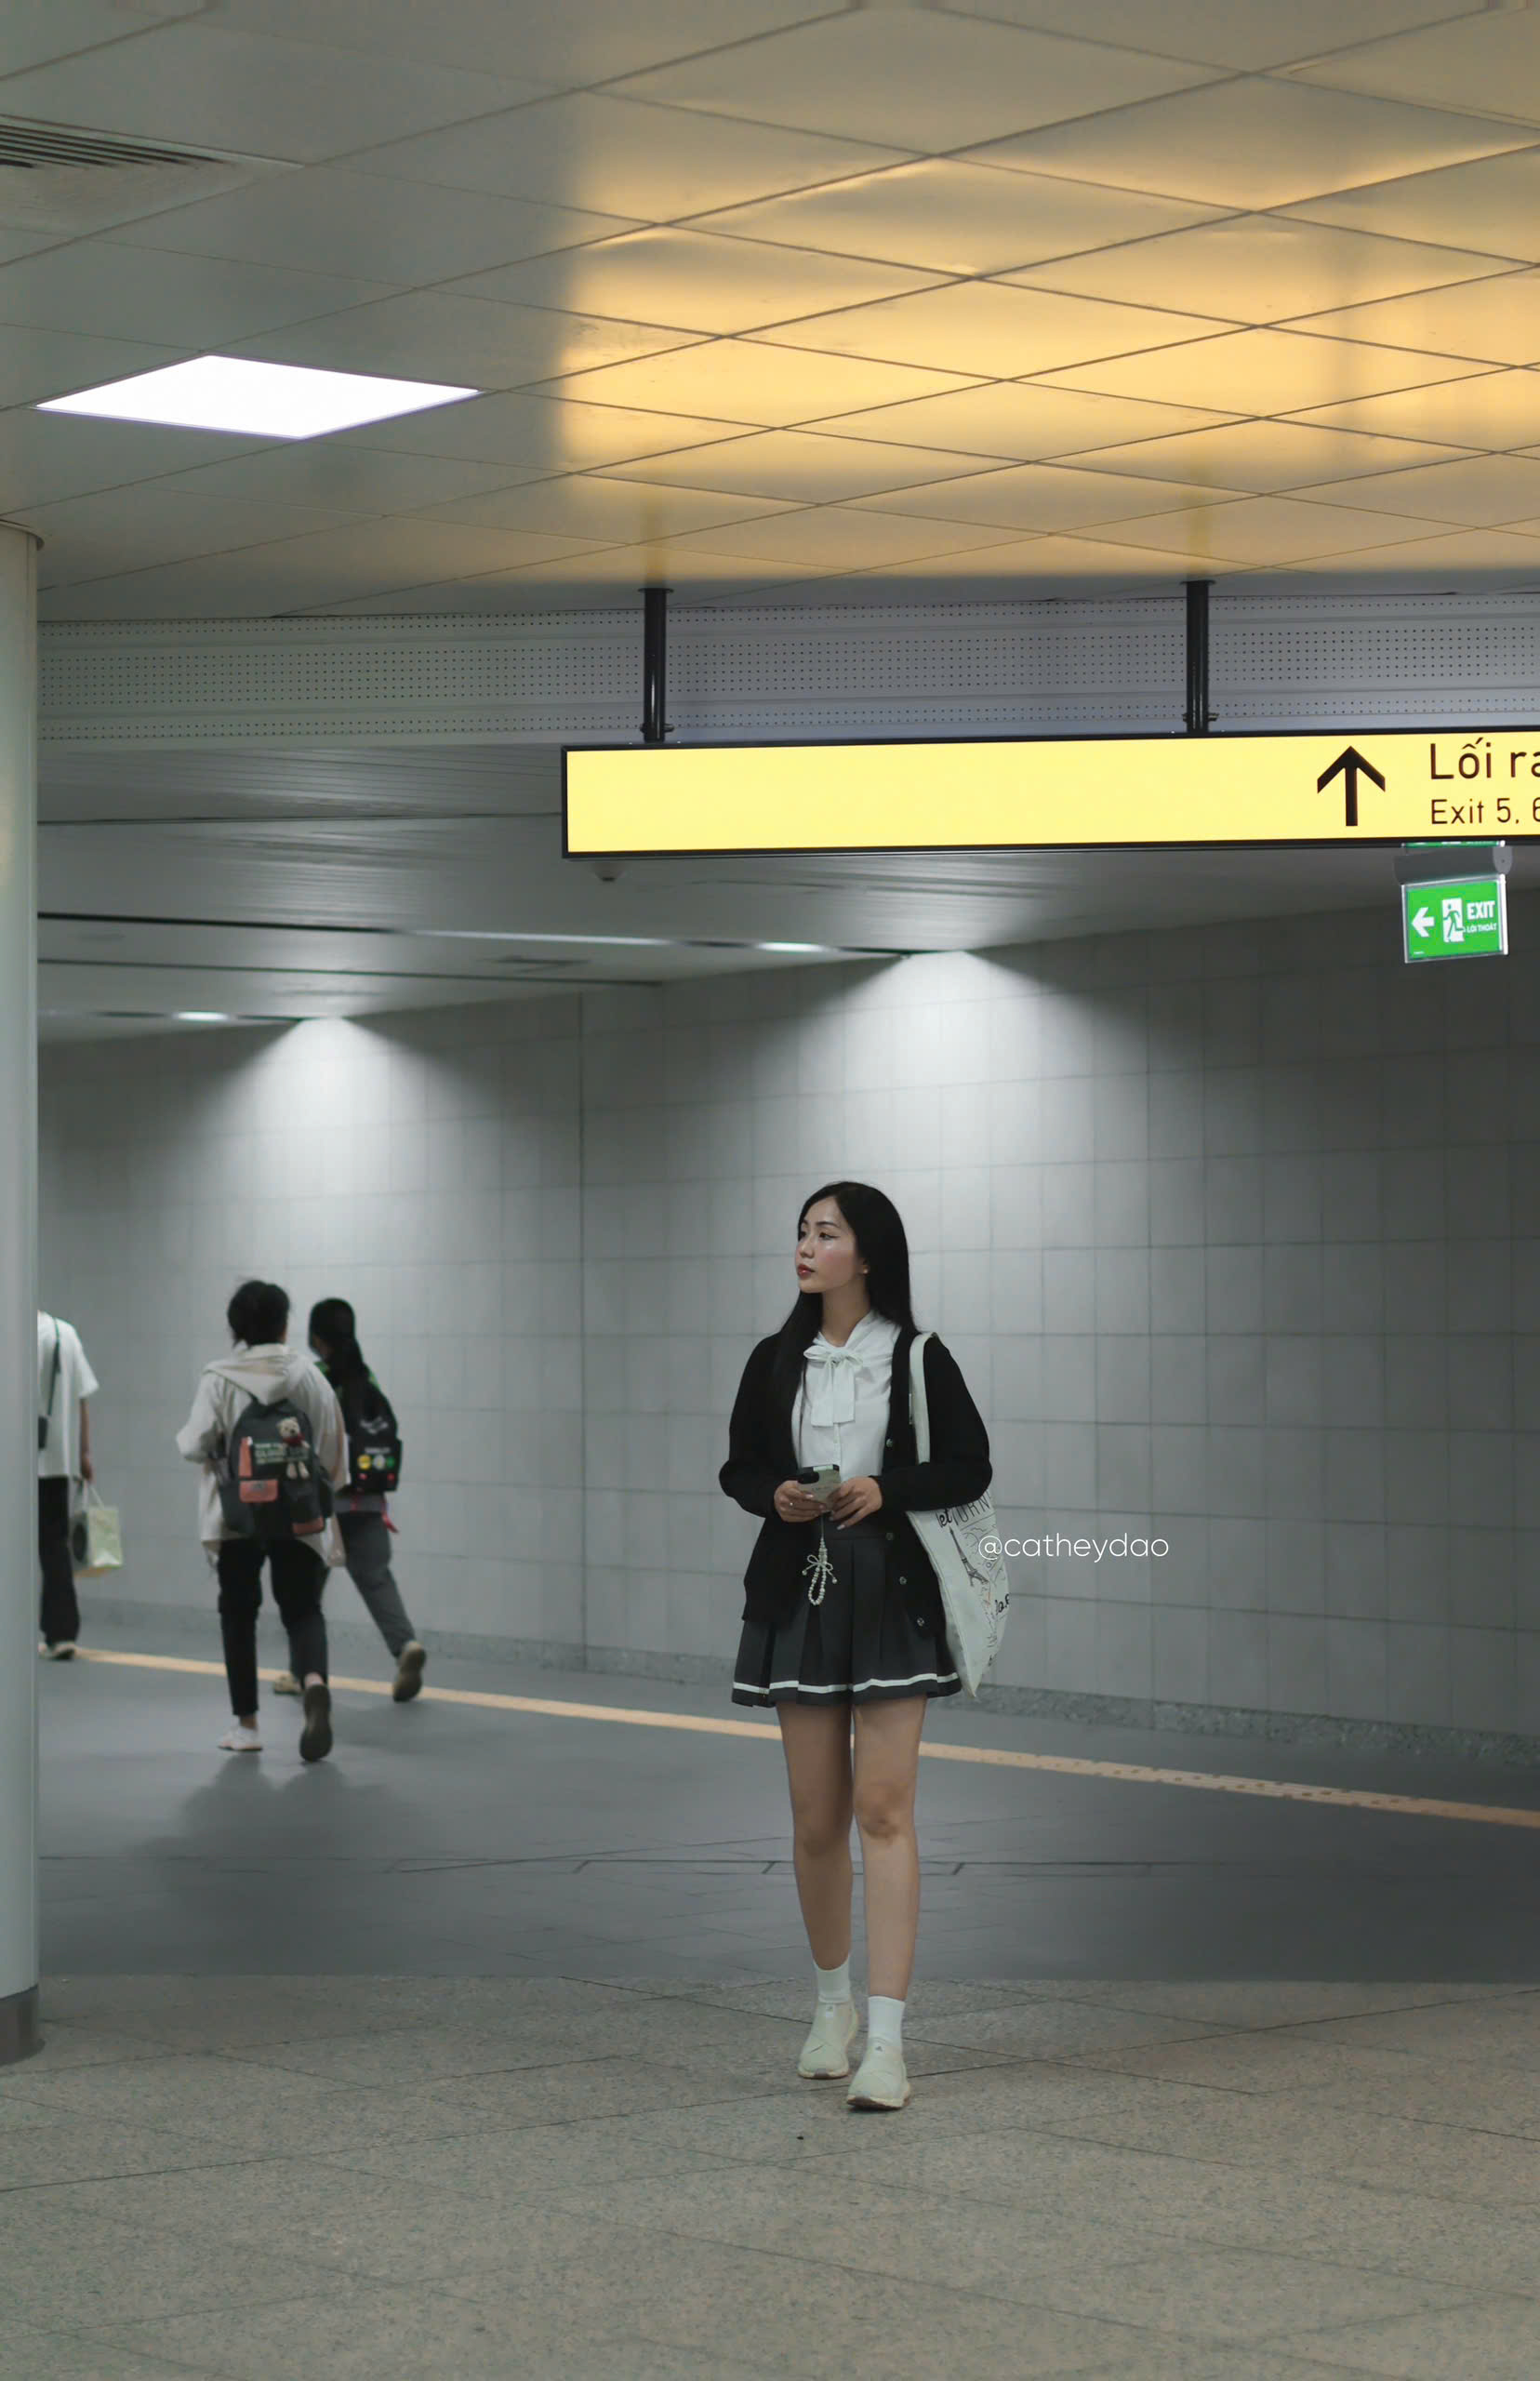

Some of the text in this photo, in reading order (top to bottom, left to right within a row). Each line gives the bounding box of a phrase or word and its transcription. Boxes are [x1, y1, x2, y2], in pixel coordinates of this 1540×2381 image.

[1429, 737, 1492, 780] Lối
[1431, 798, 1484, 825] Exit
[1467, 901, 1495, 919] EXIT
